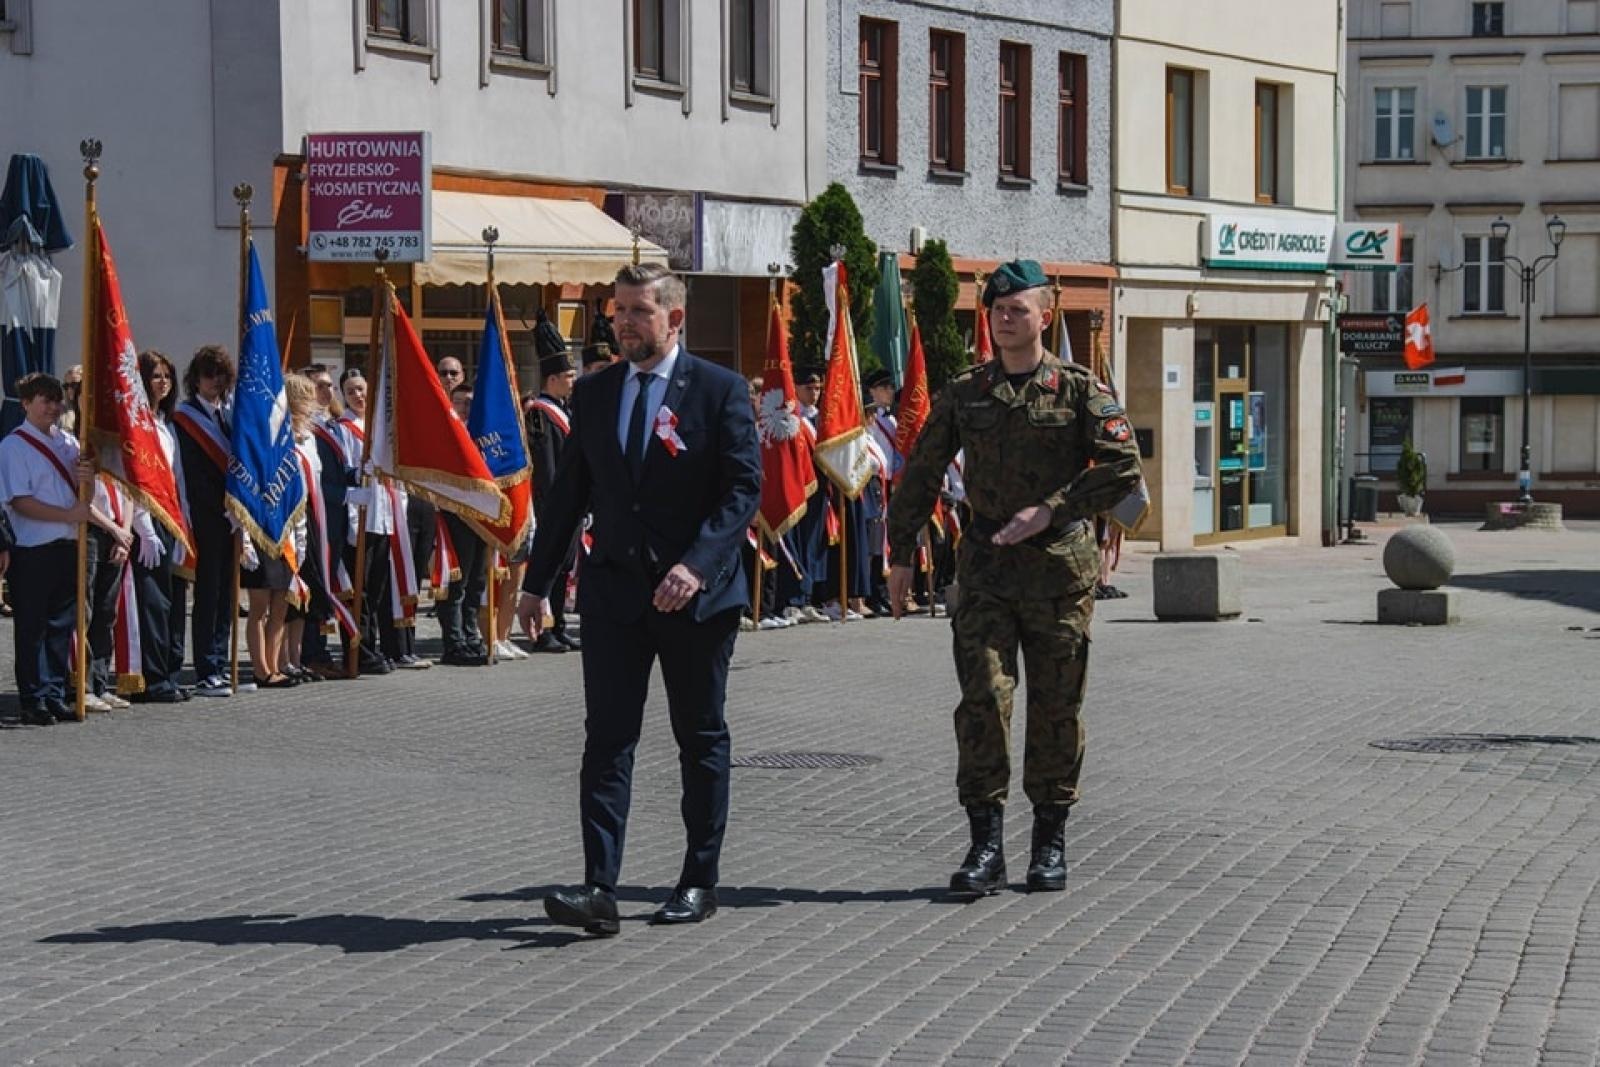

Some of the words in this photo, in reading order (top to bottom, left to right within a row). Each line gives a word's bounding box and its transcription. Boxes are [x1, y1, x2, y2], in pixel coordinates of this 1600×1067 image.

[310, 140, 421, 158] HURTOWNIA
[310, 162, 400, 177] FRYZJERSKO-
[311, 181, 422, 196] -KOSMETYCZNA
[336, 199, 394, 229] Elmi
[329, 237, 349, 248] +48
[352, 236, 371, 248] 782
[375, 236, 395, 248] 745
[399, 236, 418, 248] 783
[1239, 229, 1277, 251] CRÉDIT
[1278, 232, 1326, 253] AGRICOLE
[1343, 332, 1401, 341] DORABIANIE
[1354, 341, 1390, 350] KLUCZY
